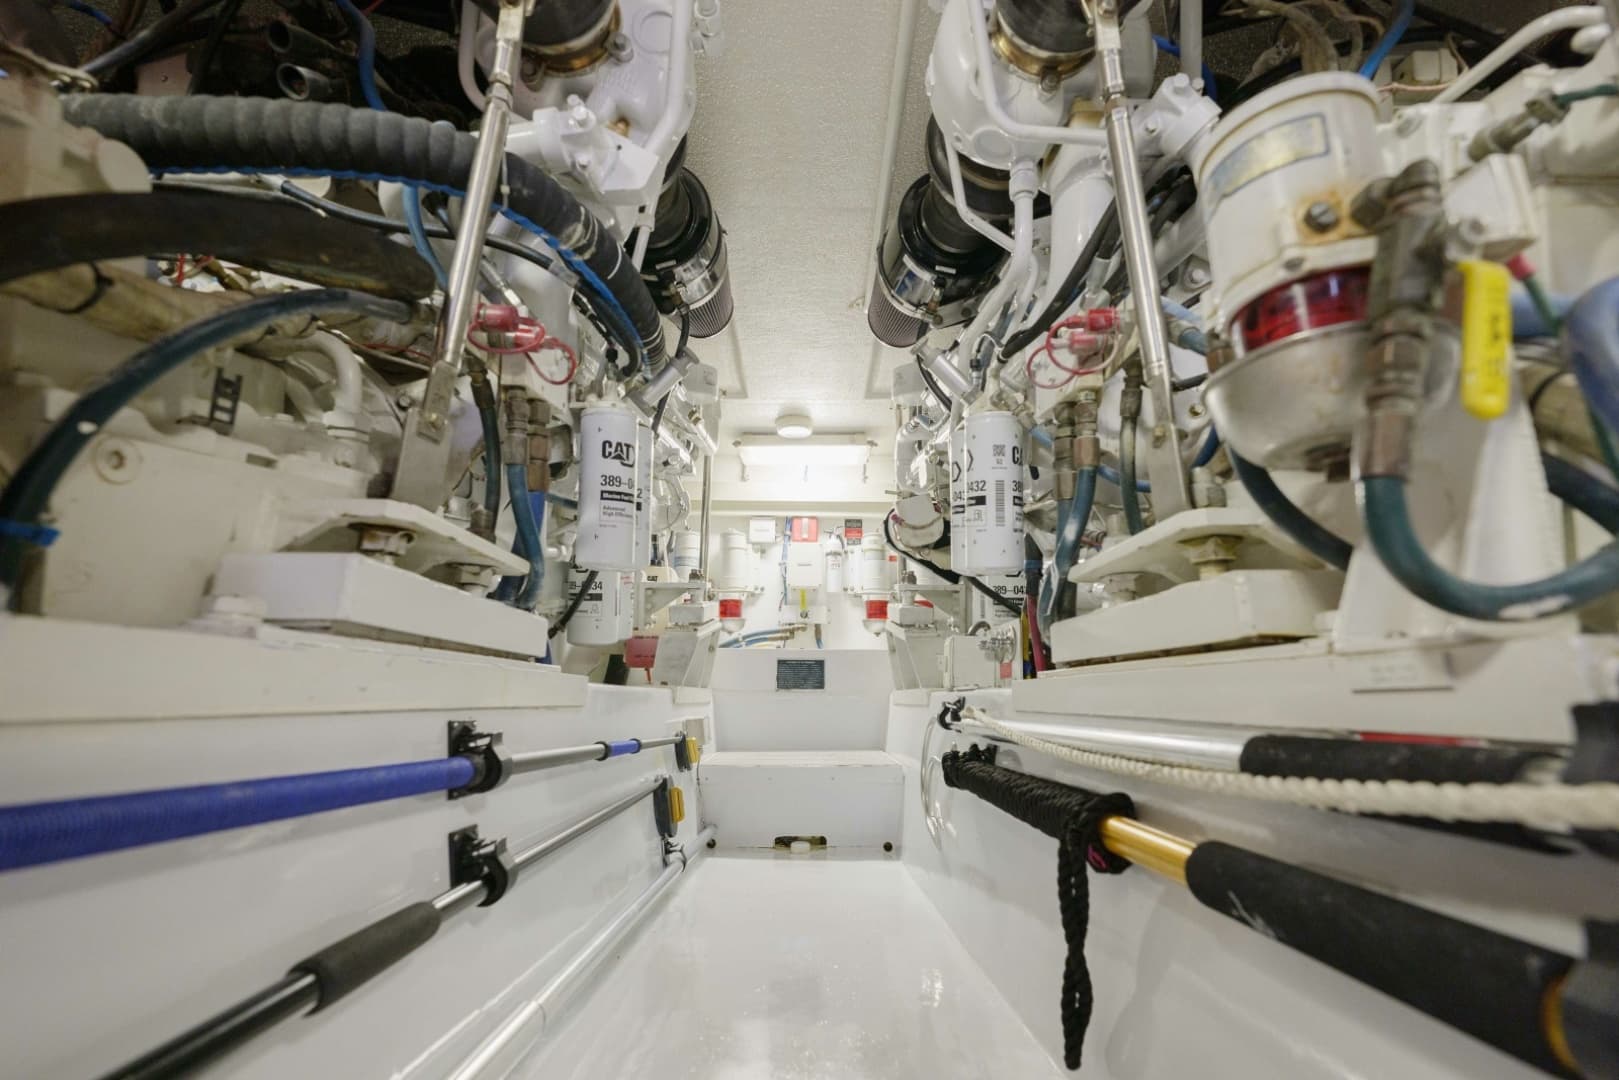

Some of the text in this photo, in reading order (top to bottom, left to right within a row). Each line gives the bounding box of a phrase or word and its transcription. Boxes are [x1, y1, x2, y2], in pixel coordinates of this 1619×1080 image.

[602, 440, 632, 461] CAT
[600, 474, 635, 489] 389-0
[993, 585, 1026, 595] 389-04
